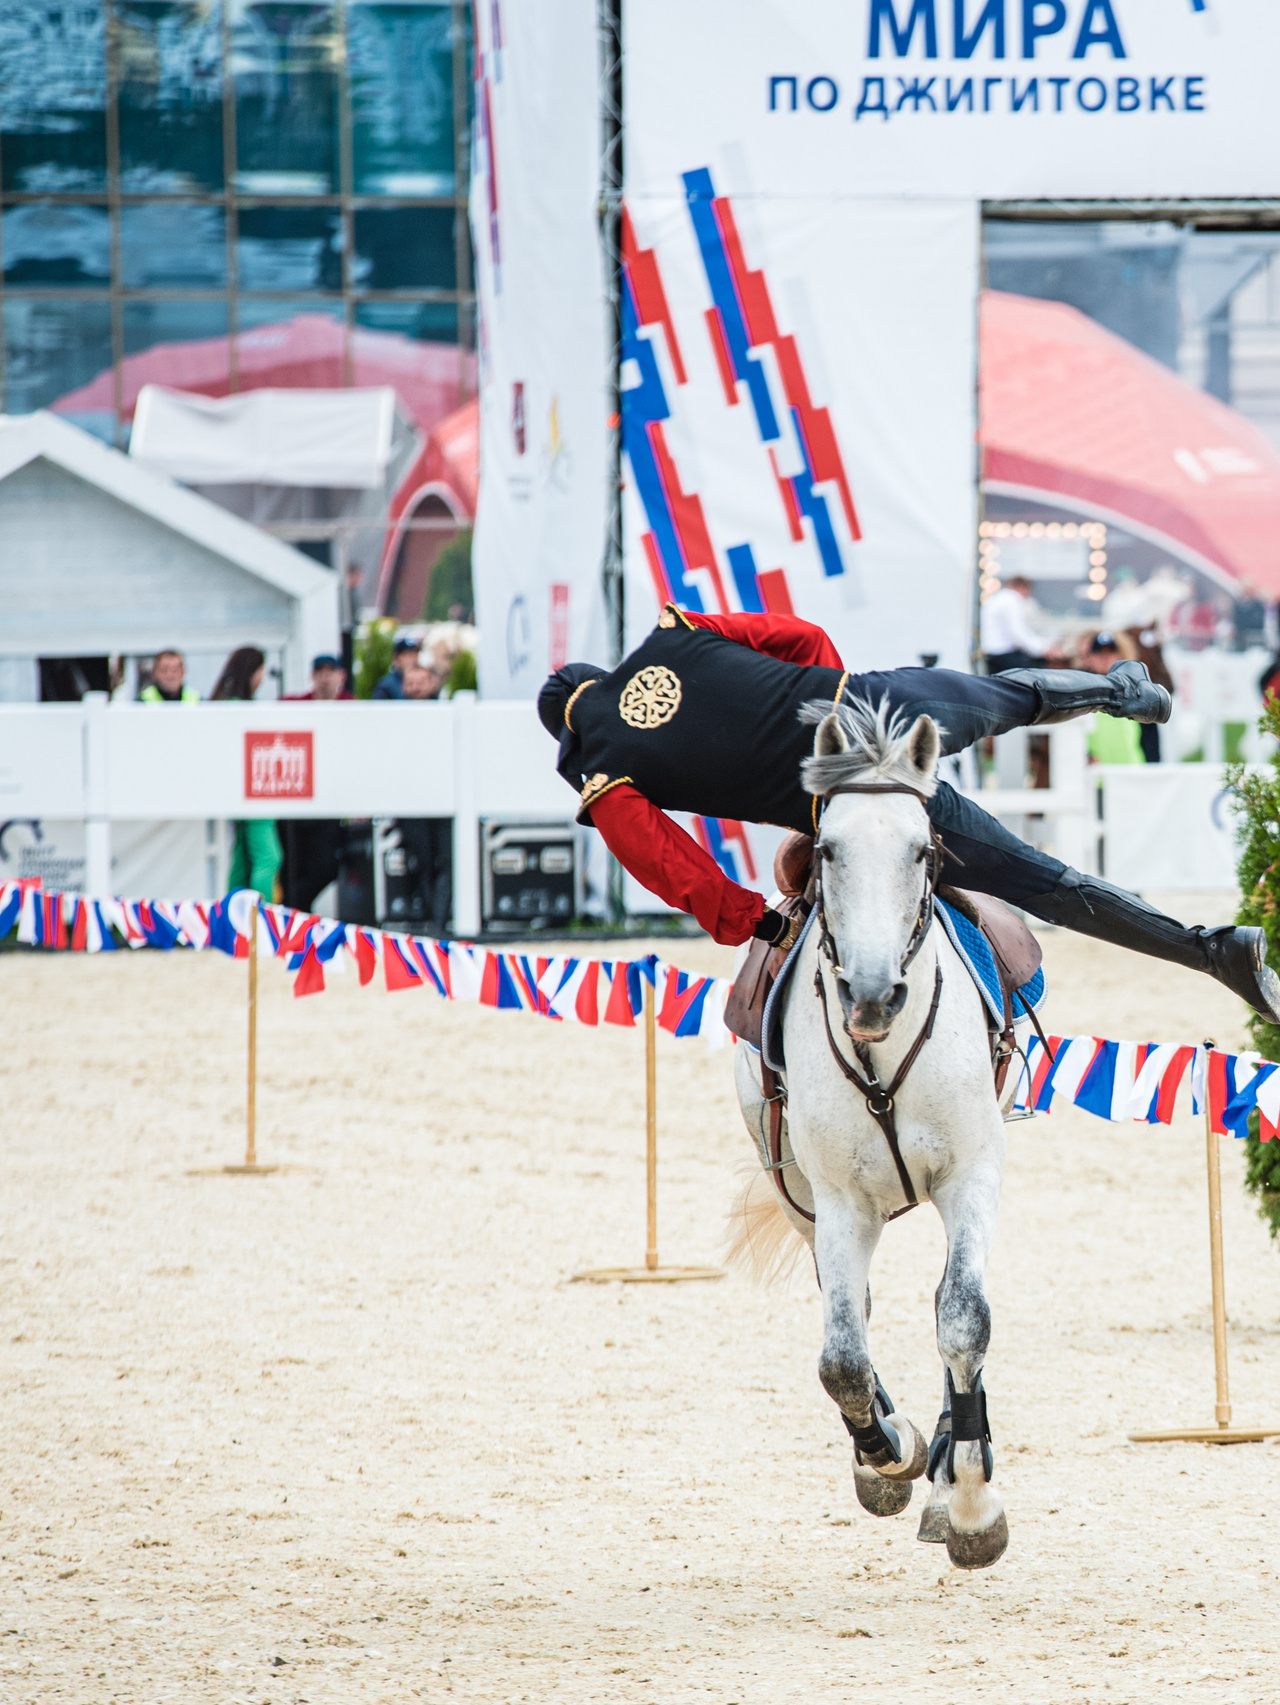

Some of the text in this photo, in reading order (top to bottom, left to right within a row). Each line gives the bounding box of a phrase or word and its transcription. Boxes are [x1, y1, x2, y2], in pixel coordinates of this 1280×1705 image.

[867, 0, 1127, 59] МИРА
[768, 76, 1206, 121] ПО ДЖИГИТОВКЕ
